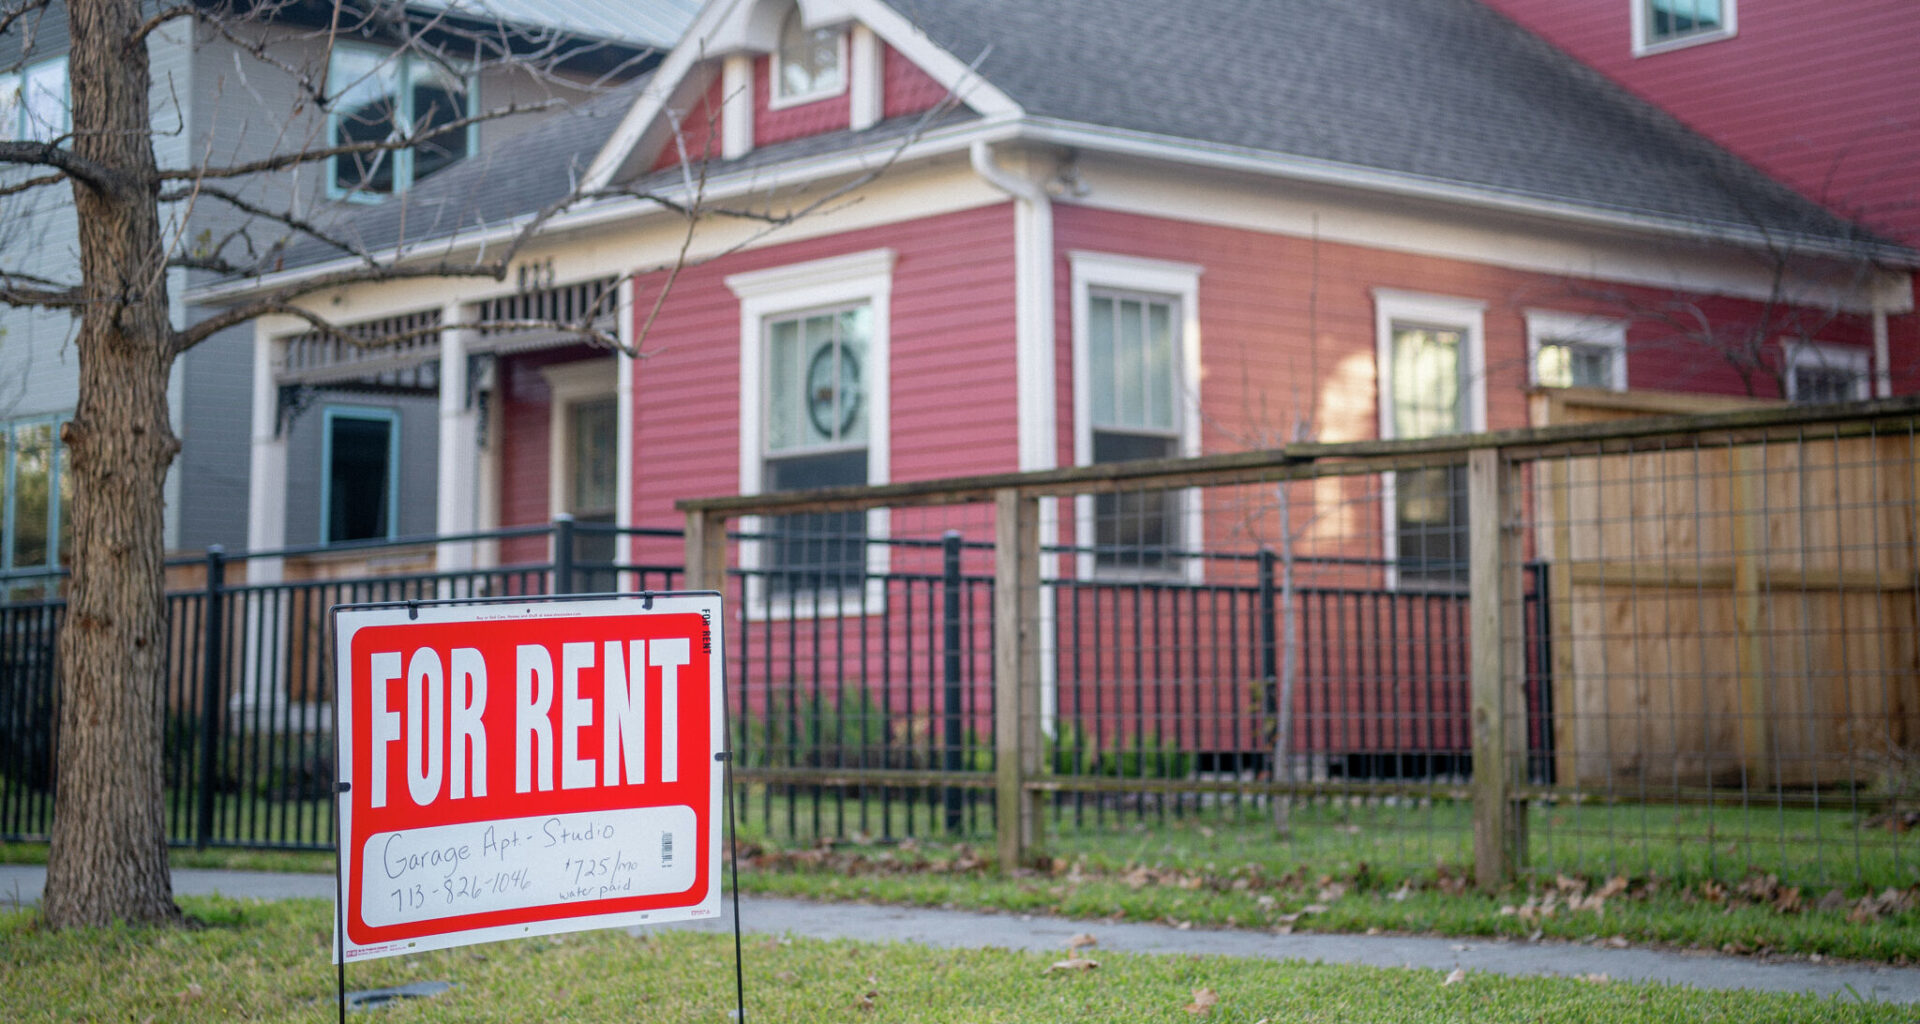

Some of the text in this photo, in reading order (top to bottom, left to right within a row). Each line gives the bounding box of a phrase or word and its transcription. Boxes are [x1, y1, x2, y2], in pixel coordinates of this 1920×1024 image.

[702, 608, 712, 654] FOR RENT
[371, 637, 691, 809] FOR RENT
[383, 833, 471, 879] Garage
[543, 817, 615, 848] Studio
[391, 867, 531, 912] 713-826-1046
[559, 877, 631, 900] water paid
